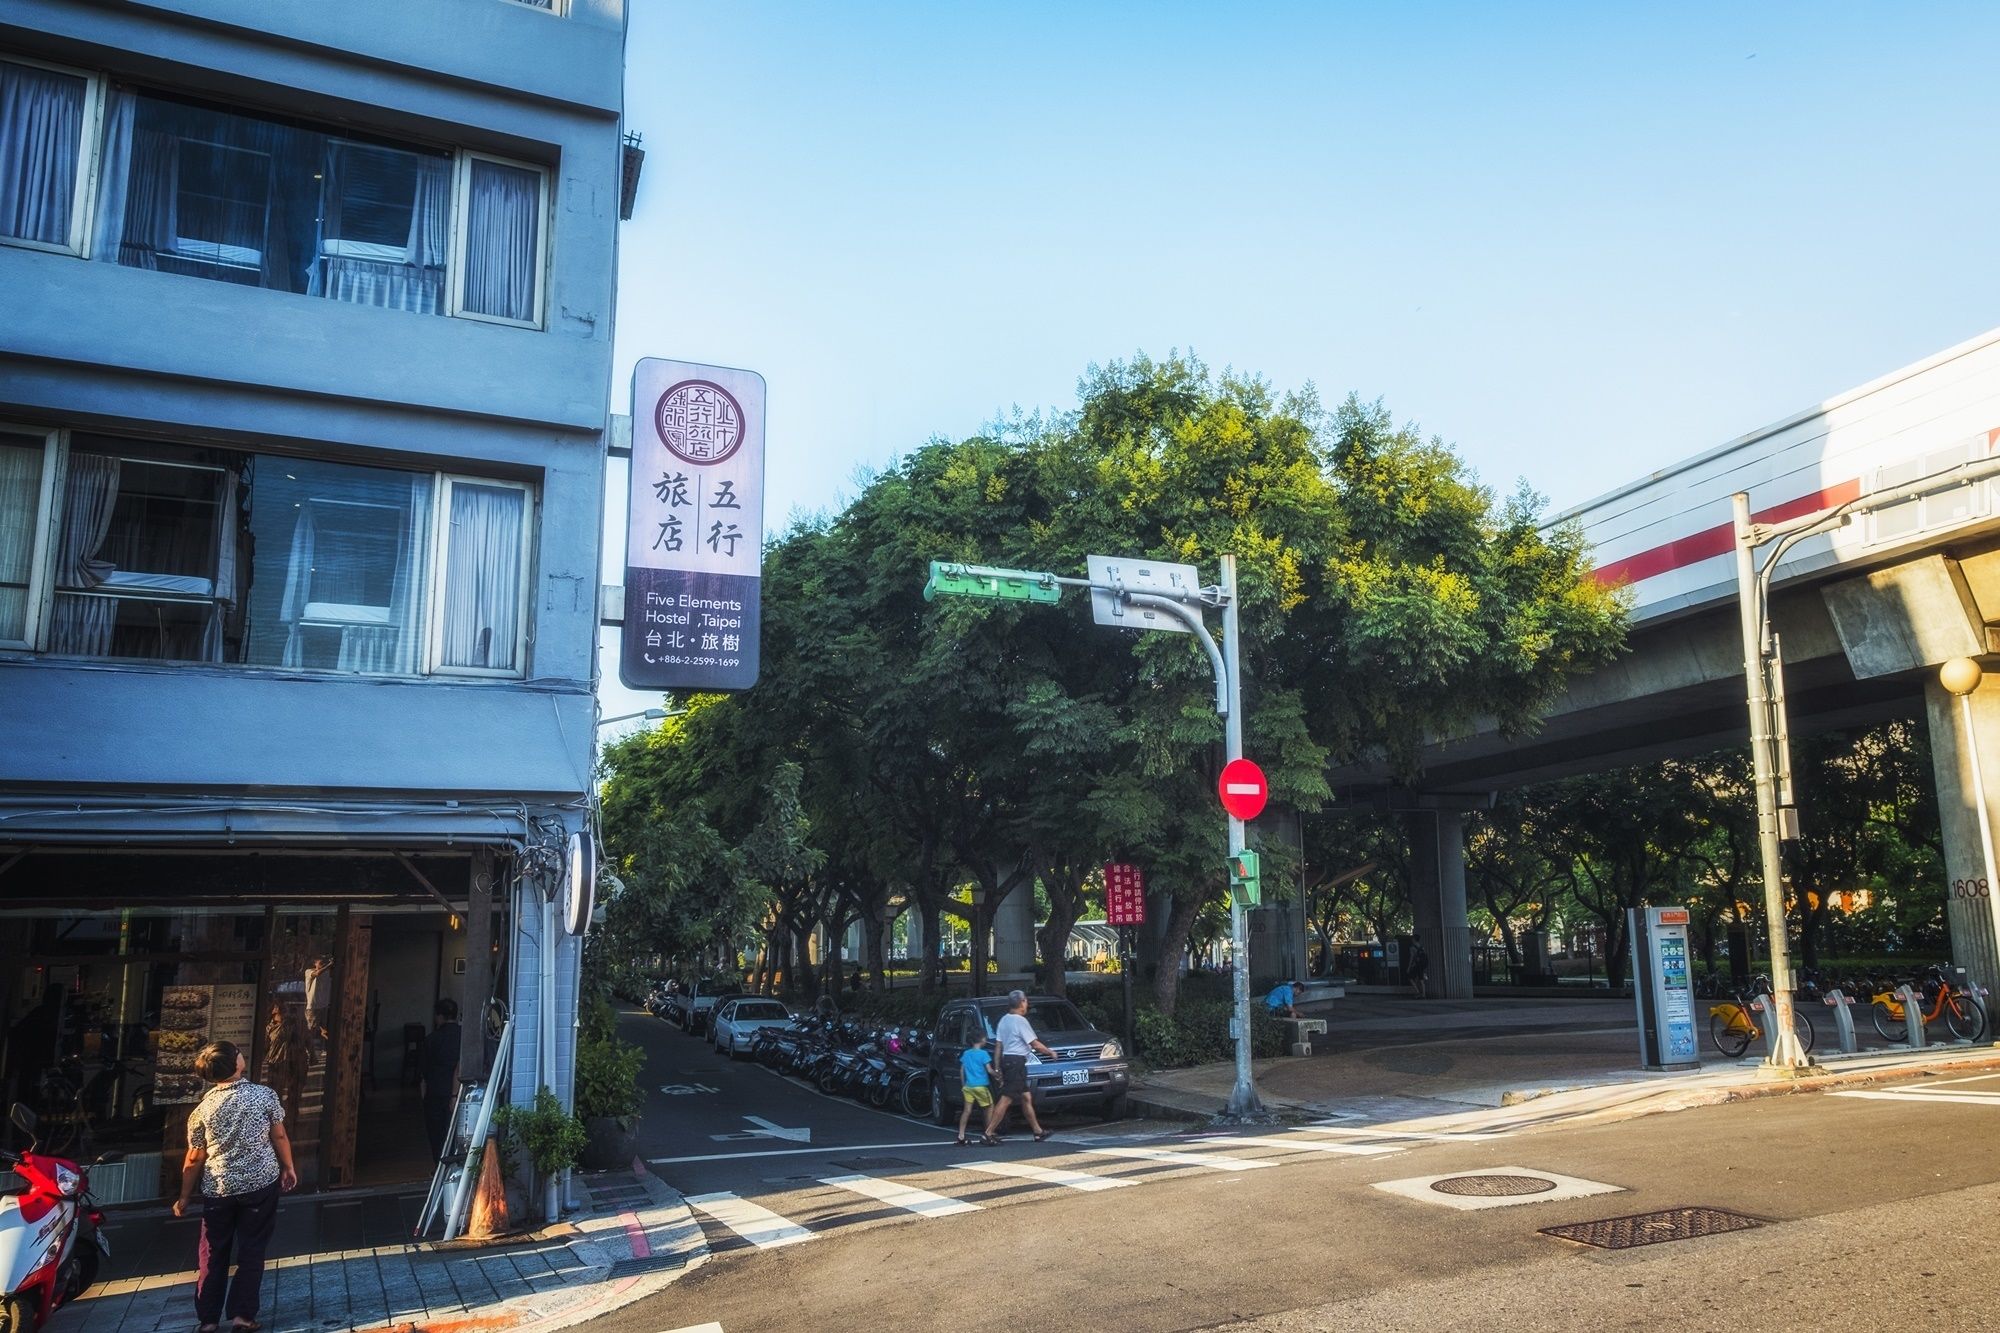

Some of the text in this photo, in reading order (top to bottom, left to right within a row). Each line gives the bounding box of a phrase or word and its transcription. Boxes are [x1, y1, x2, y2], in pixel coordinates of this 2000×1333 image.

[652, 471, 693, 553] 旅店
[706, 480, 743, 558] 五行
[646, 591, 742, 611] Five Elements
[645, 609, 690, 625] Hostel
[658, 654, 740, 667] +886-2-2599-1699
[1952, 878, 1990, 898] 1608
